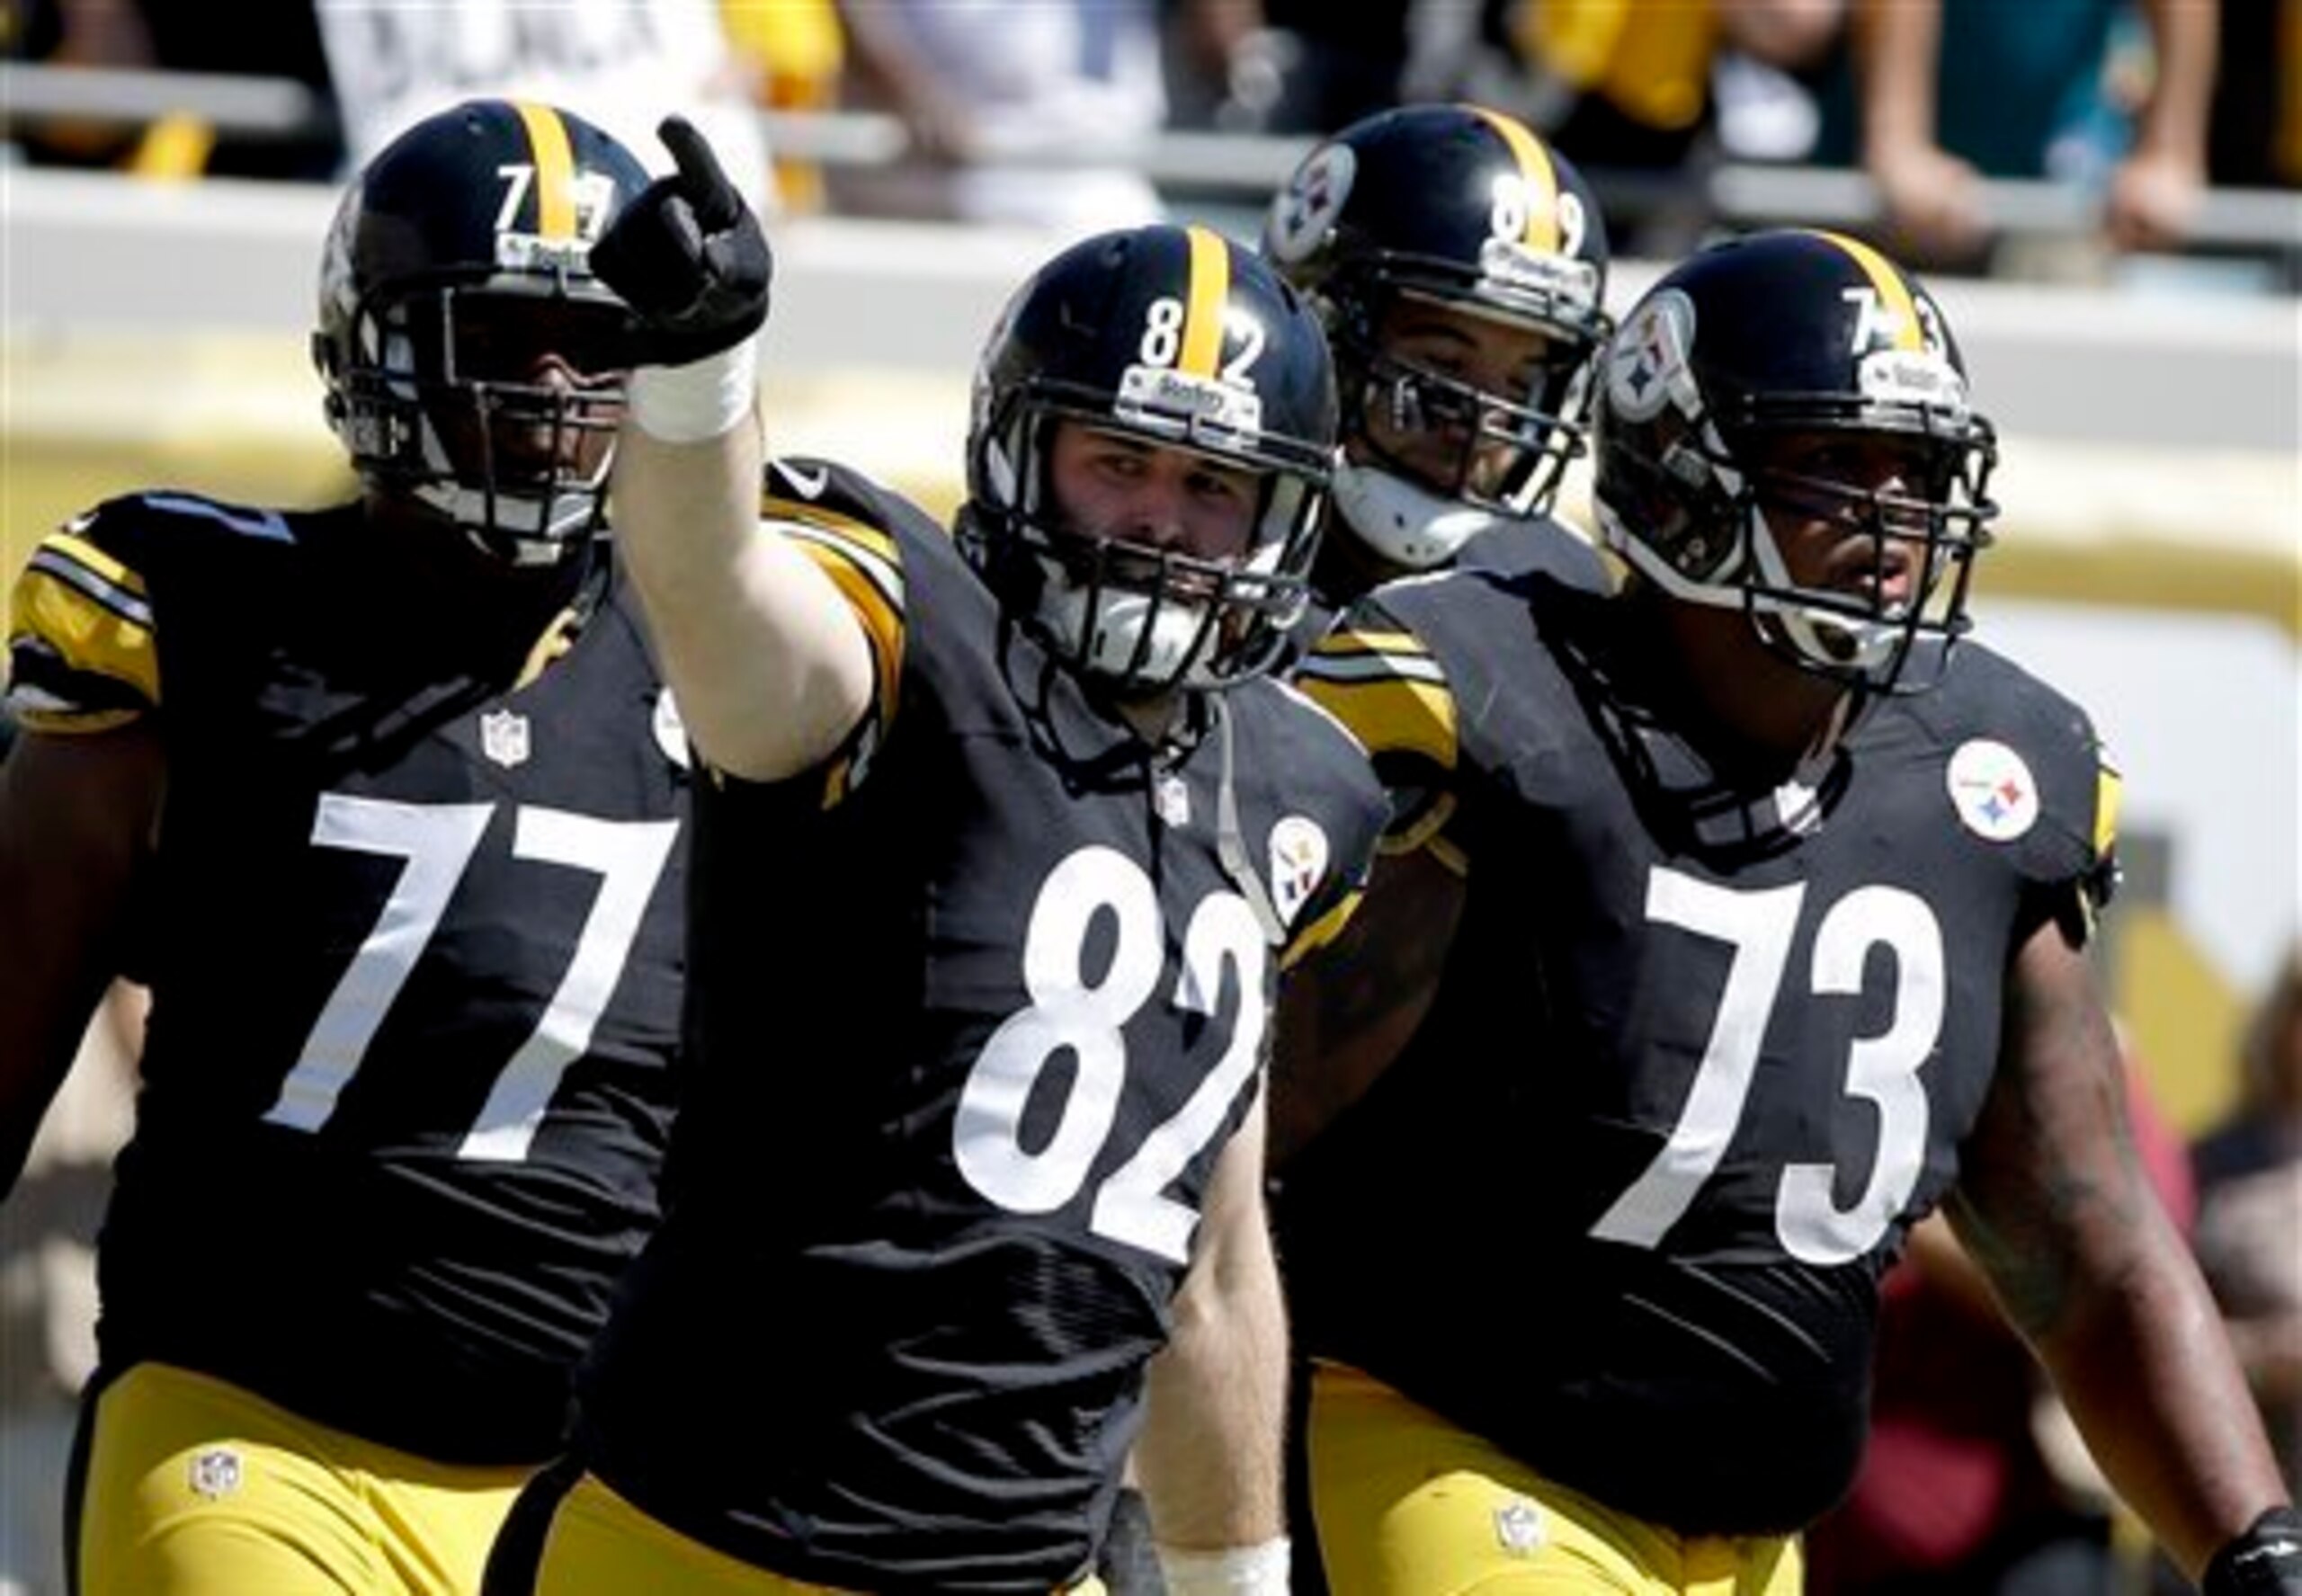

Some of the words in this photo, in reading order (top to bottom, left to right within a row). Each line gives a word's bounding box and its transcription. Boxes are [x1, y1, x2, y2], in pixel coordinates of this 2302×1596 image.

[1140, 298, 1265, 393] 82
[260, 791, 681, 1161] 77
[953, 844, 1264, 1264] 82
[1587, 865, 1946, 1267] 73
